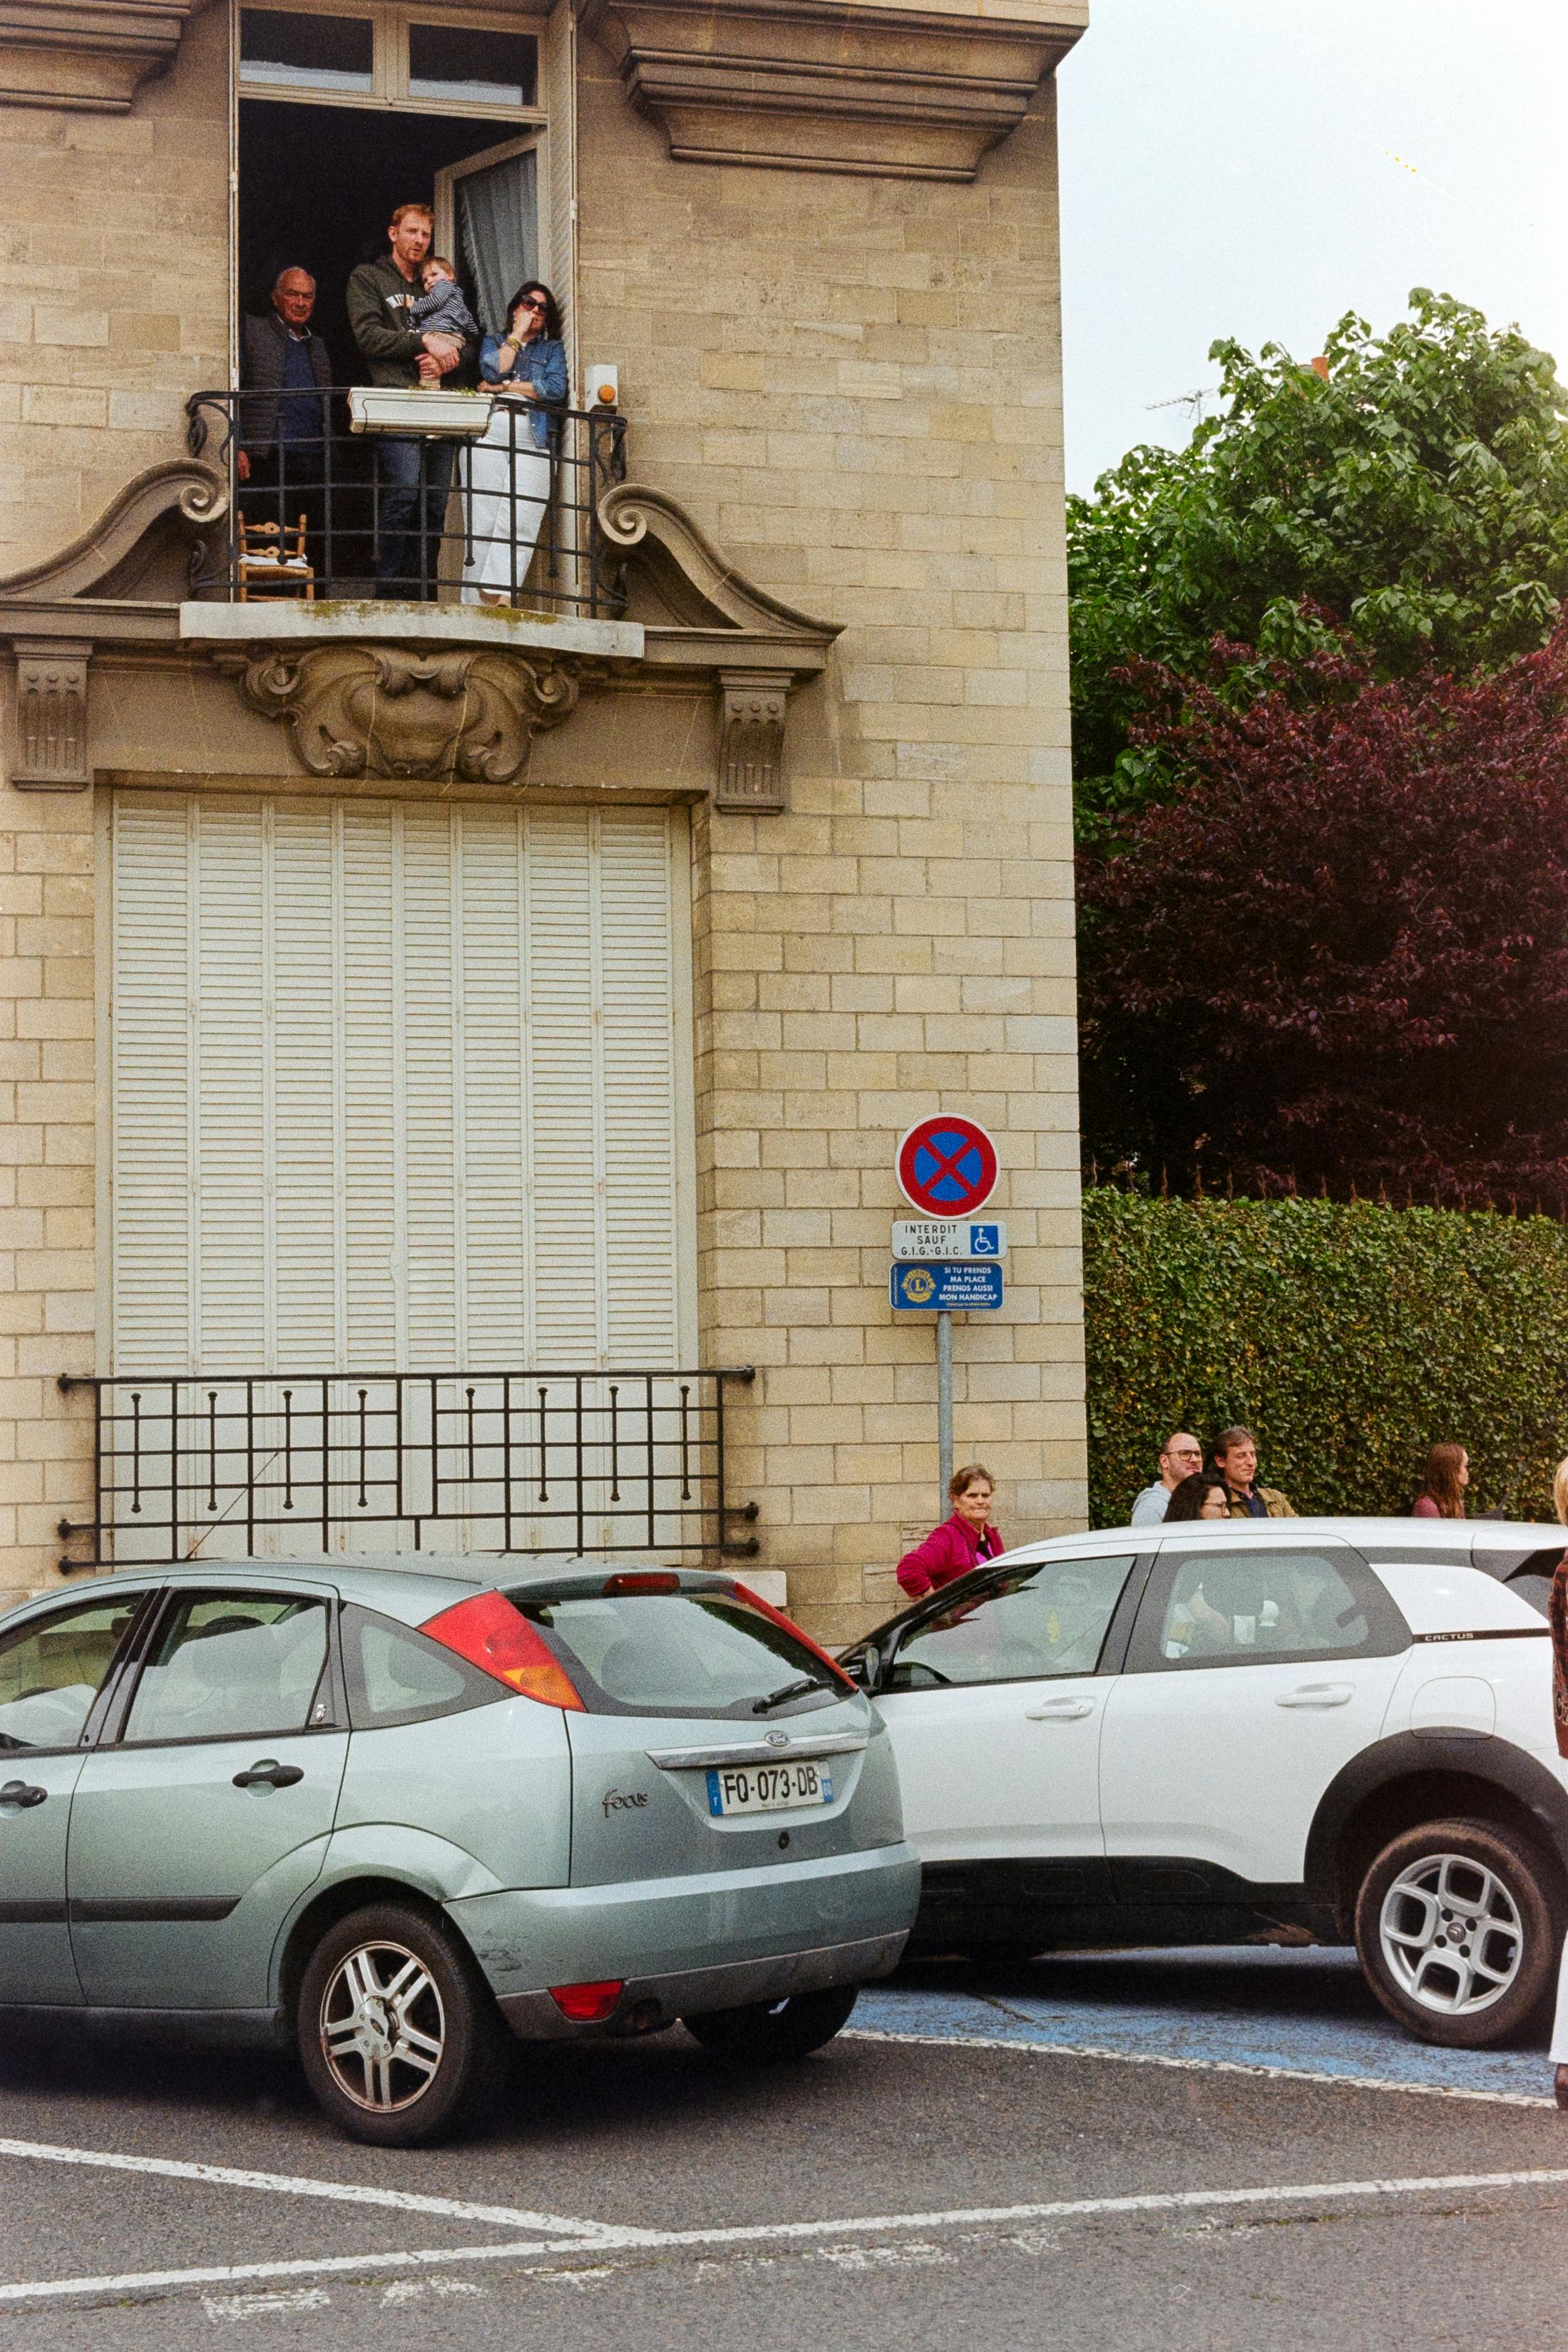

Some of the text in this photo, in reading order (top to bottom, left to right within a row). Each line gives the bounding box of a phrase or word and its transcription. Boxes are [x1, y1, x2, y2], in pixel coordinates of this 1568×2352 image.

[905, 1224, 958, 1234] INTERDIT
[917, 1235, 947, 1244] SAUF
[915, 1279, 924, 1292] L
[1425, 1632, 1474, 1641] CACTUS
